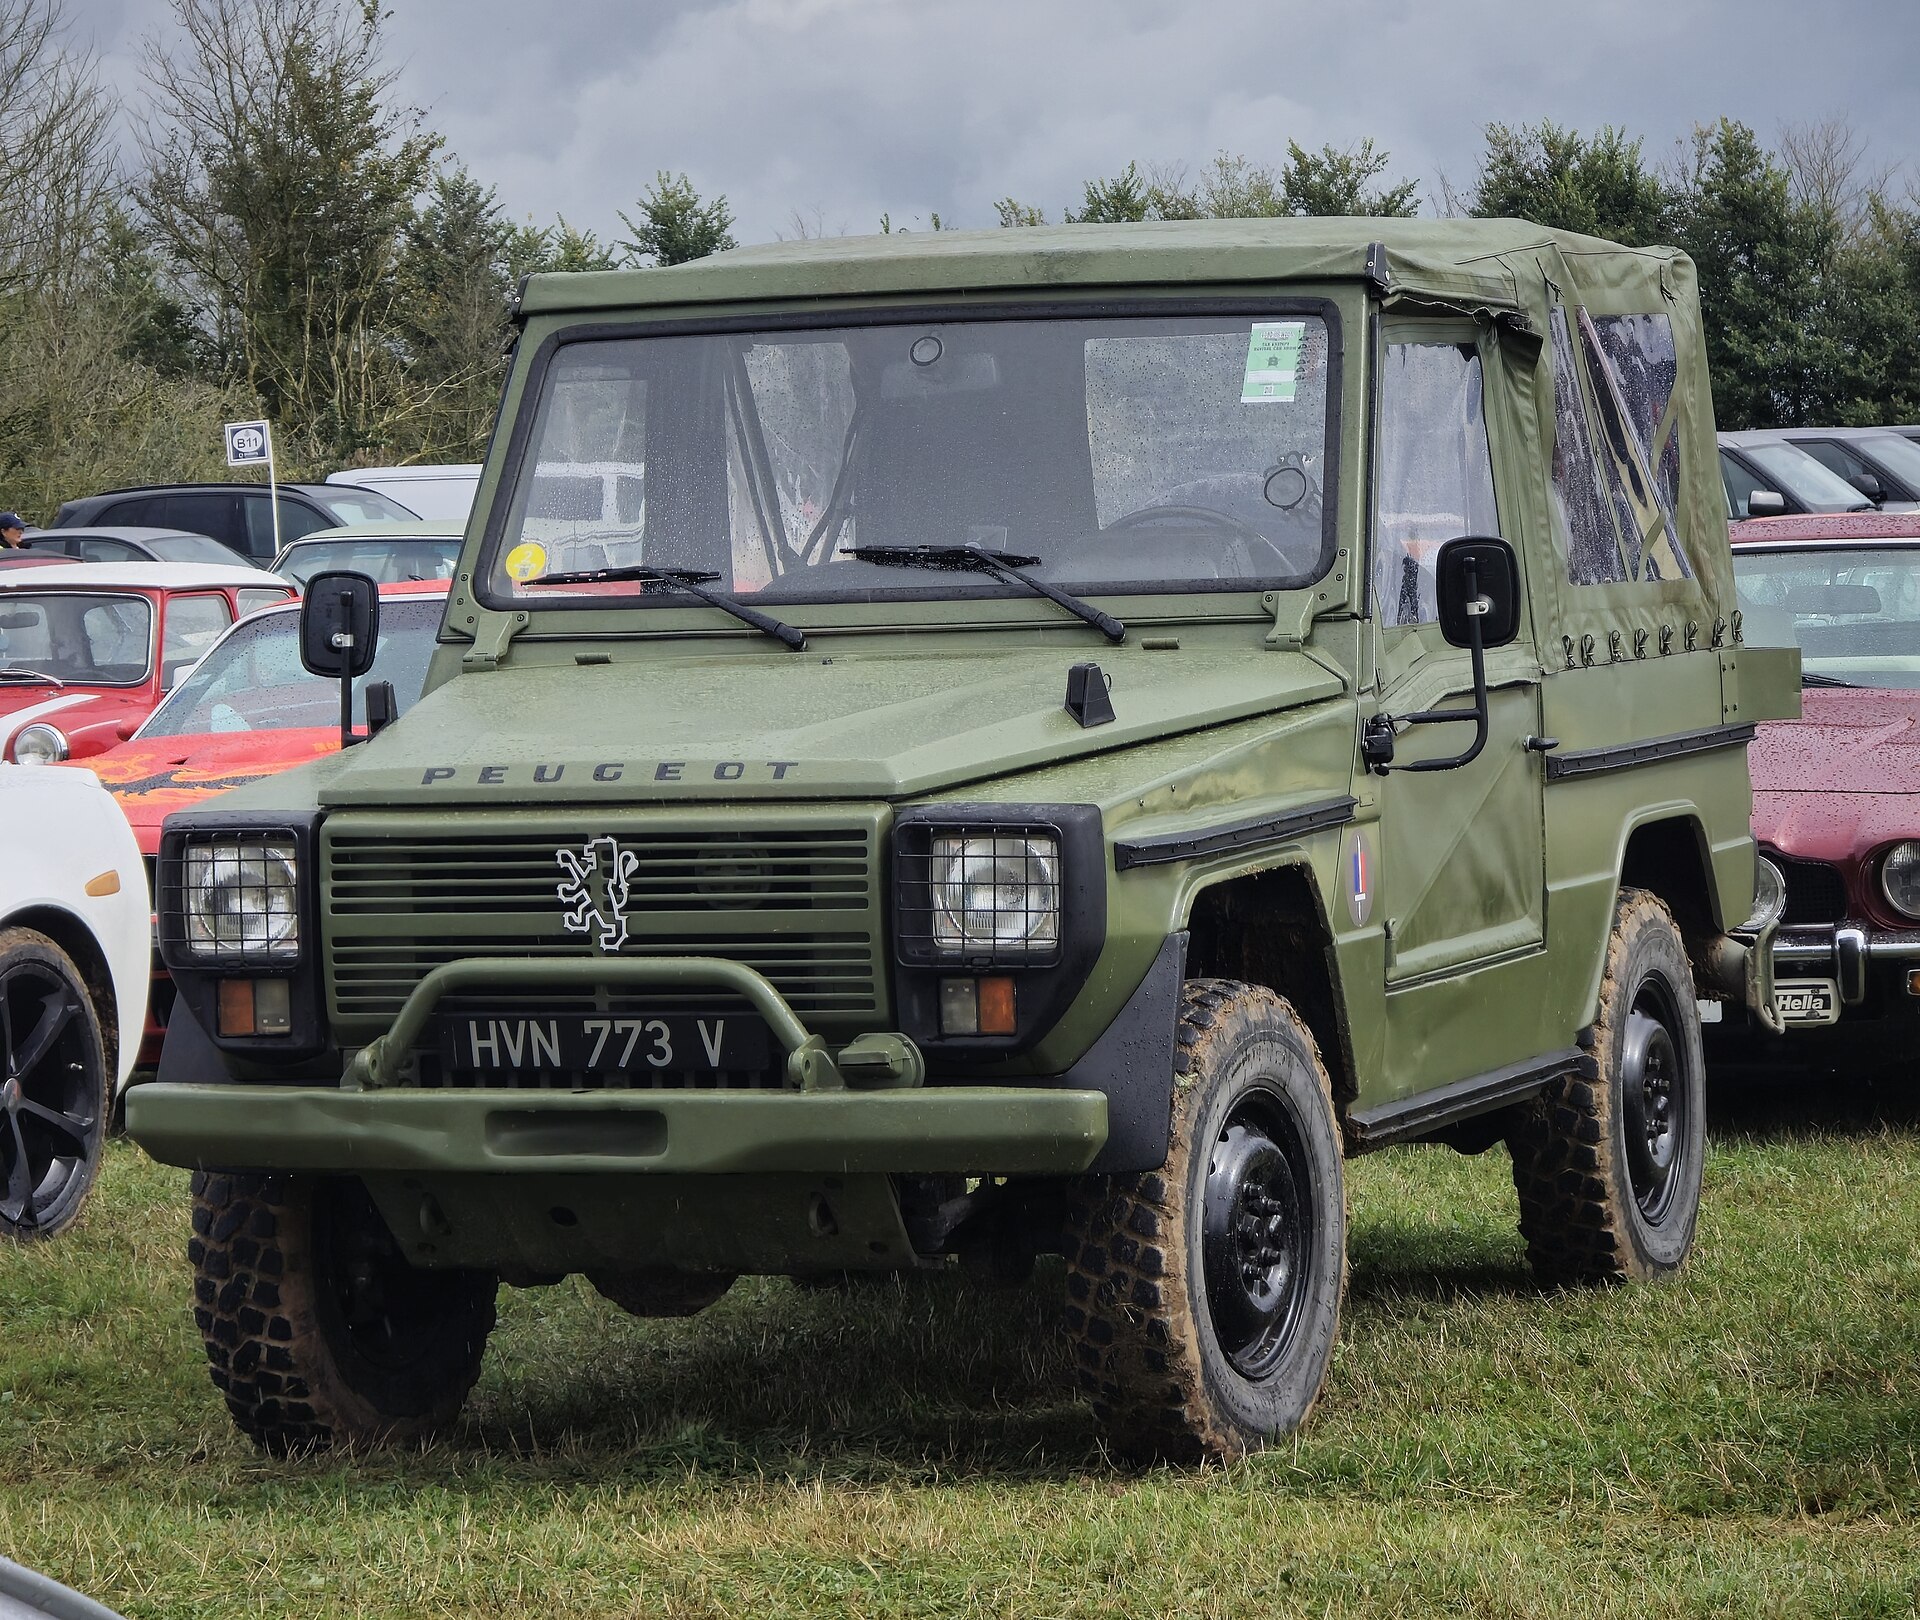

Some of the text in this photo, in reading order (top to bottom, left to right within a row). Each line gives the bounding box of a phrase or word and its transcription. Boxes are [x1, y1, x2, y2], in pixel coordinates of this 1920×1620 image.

[237, 437, 258, 449] B11
[421, 762, 799, 785] PEUGEOT
[1778, 995, 1824, 1010] Hella
[469, 1019, 725, 1067] HVN 773 V
